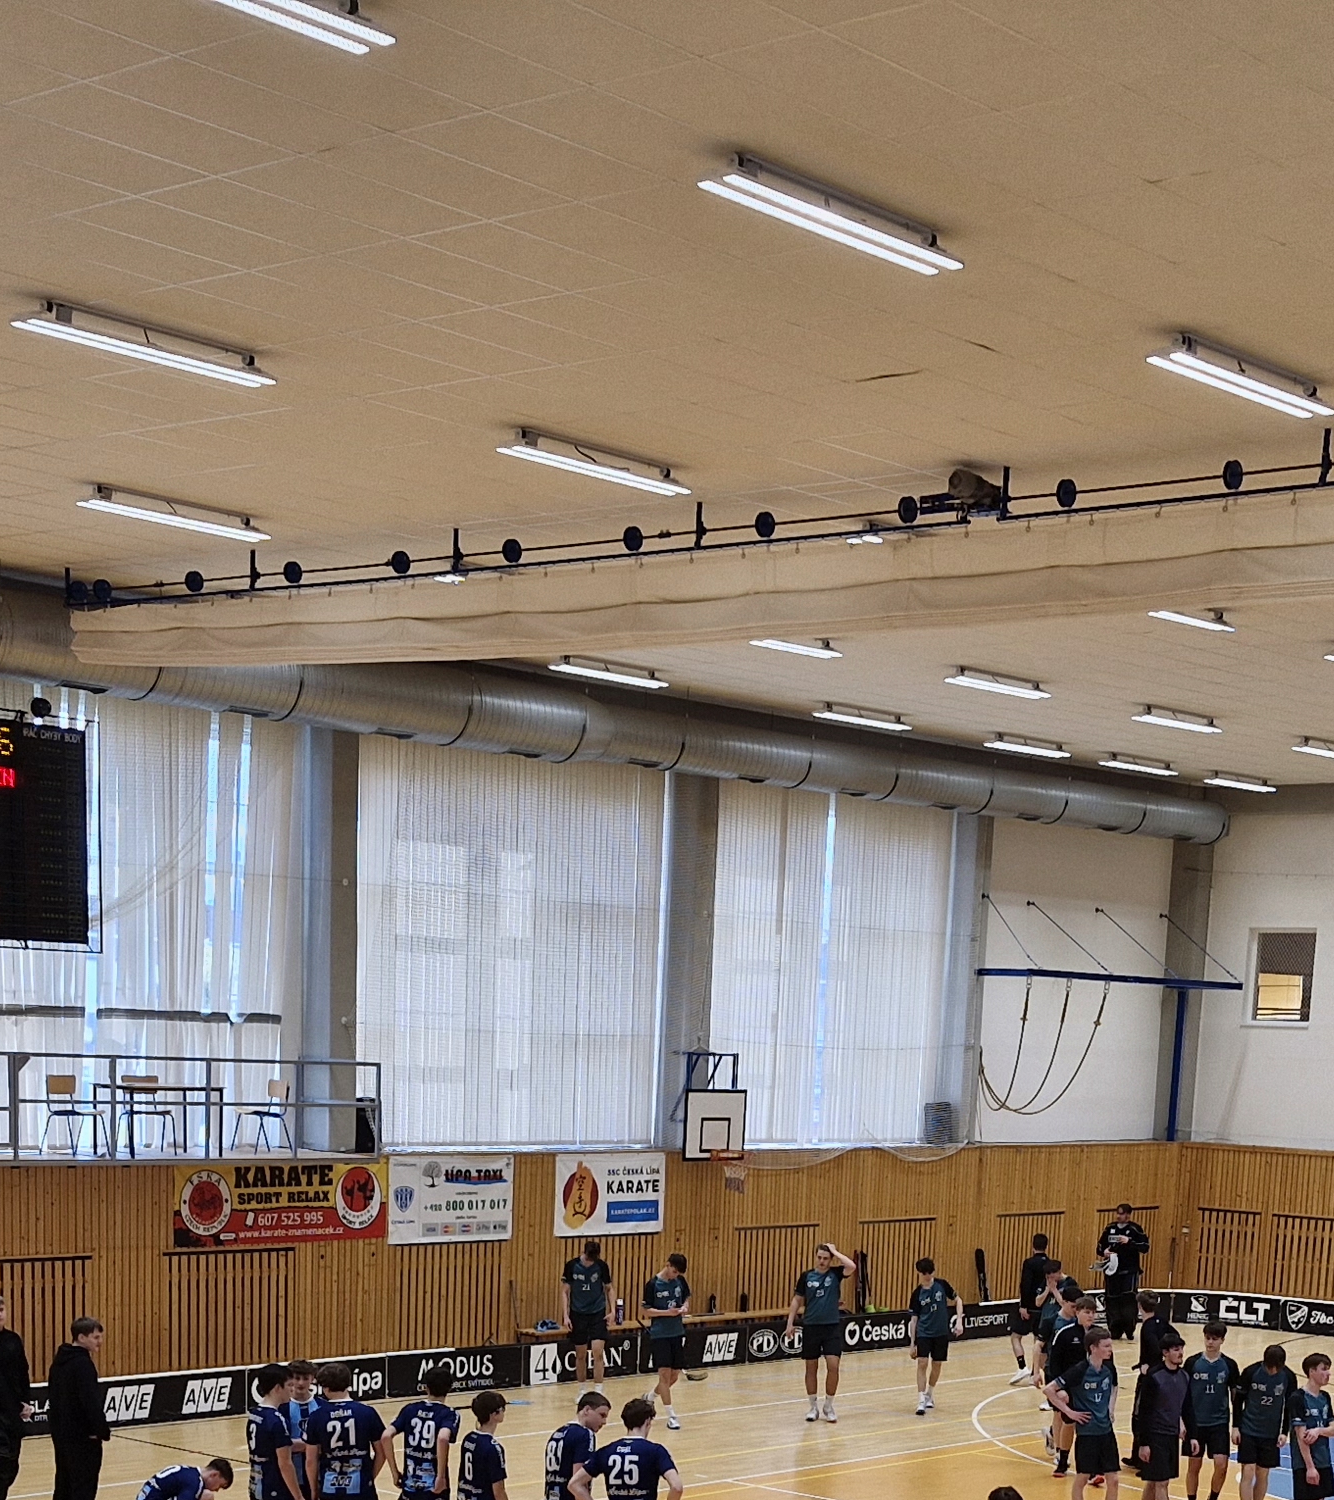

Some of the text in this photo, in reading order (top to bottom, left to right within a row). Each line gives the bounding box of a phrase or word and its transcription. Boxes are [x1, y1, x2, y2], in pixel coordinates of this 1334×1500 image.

[234, 1164, 333, 1188] KARATE
[622, 1166, 644, 1176] ČESKÁ
[645, 1166, 660, 1175] LÍPA
[237, 1190, 331, 1206] SPORT RELAX
[607, 1179, 660, 1194] KARATE
[445, 1199, 465, 1211] 800
[467, 1199, 486, 1210] 017
[489, 1198, 508, 1210] 017
[257, 1211, 324, 1226] 607 525 995
[861, 1319, 906, 1342] Česká
[964, 1313, 1009, 1328] LIVESPORT
[703, 1336, 737, 1359] AVE
[752, 1334, 775, 1352] PD
[350, 1368, 383, 1397] ípa
[104, 1389, 153, 1417] AVE
[183, 1382, 230, 1409] AVE
[1260, 1396, 1274, 1406] 22
[327, 1417, 357, 1449] 21
[408, 1417, 436, 1449] 39
[464, 1451, 473, 1481] 6
[608, 1454, 639, 1485] 25
